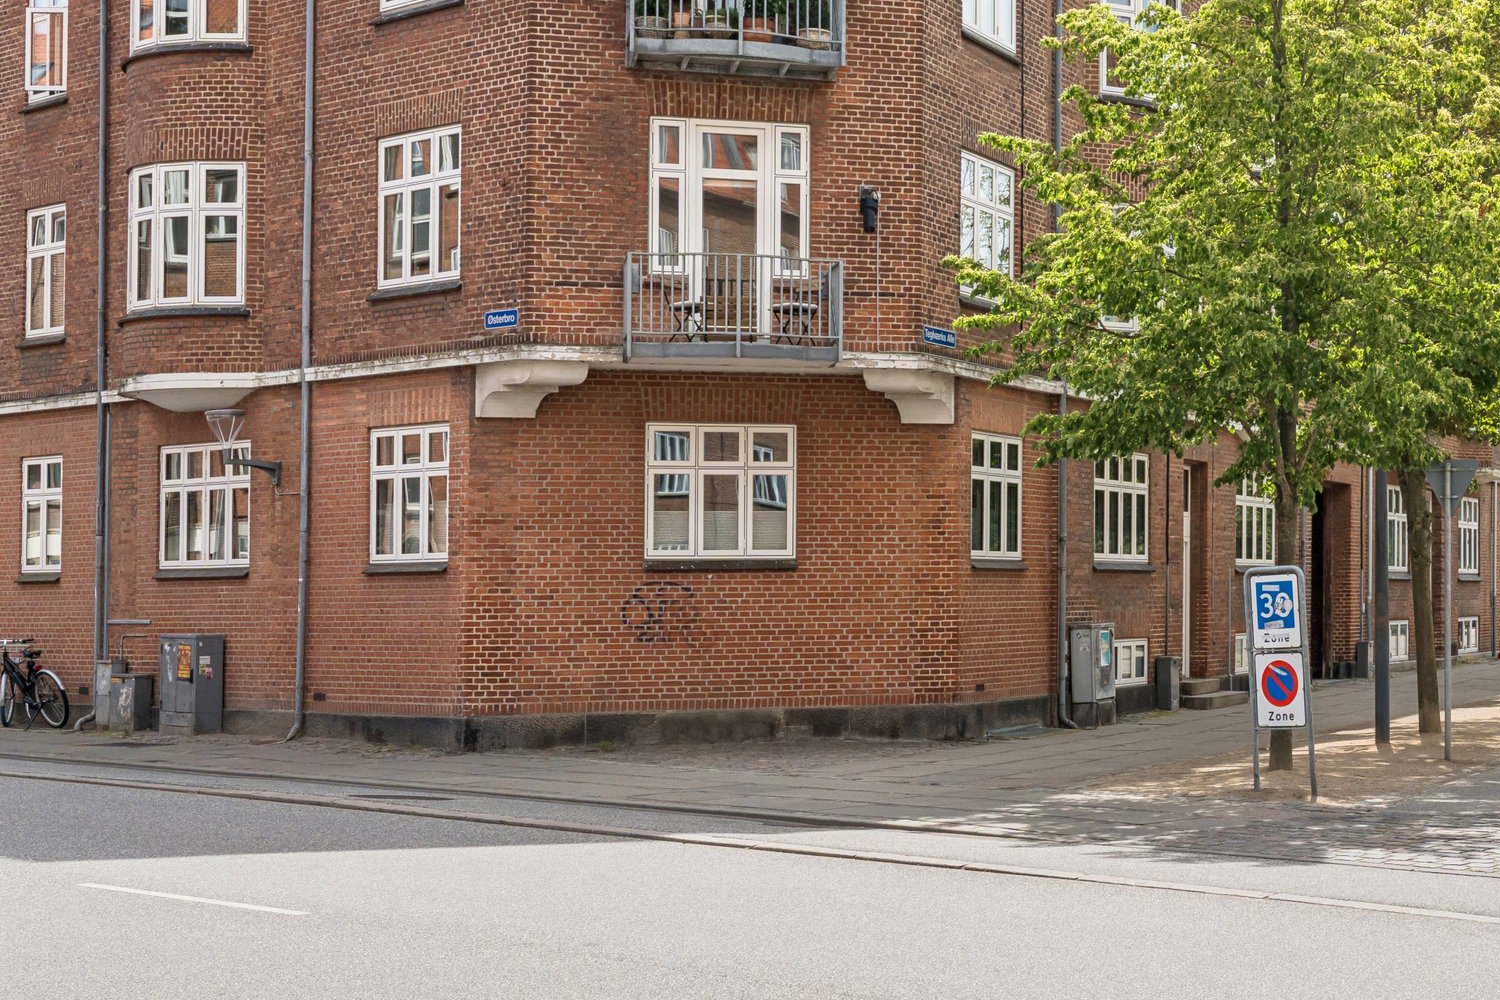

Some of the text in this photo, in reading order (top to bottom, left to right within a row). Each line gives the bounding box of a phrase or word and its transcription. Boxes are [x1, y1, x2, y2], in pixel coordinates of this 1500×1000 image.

[488, 314, 514, 324] Østerbro
[924, 328, 946, 341] Teglværks
[1260, 592, 1293, 618] 30
[1268, 711, 1295, 721] Zone
